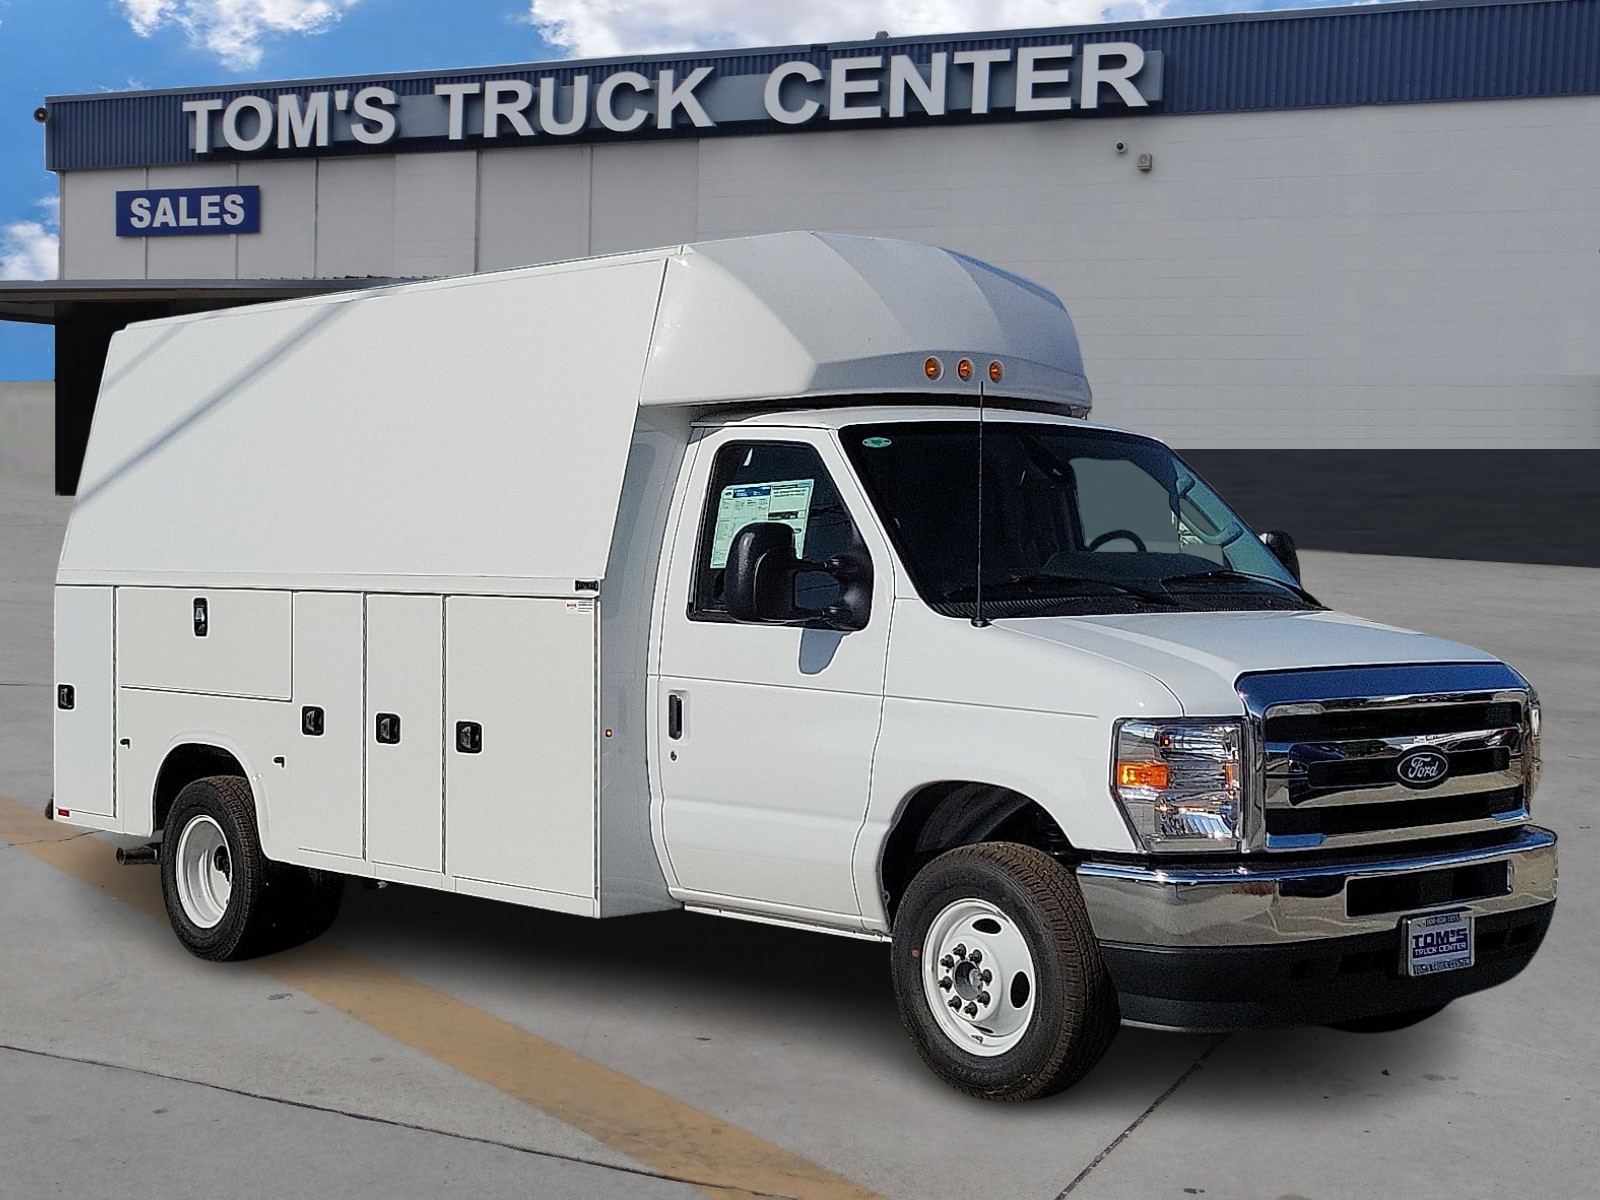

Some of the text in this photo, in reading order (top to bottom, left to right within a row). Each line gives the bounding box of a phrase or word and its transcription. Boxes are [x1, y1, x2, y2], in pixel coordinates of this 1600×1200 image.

[182, 41, 1150, 154] TOM'S TRUCK CENTER
[129, 193, 246, 230] SALES
[1407, 756, 1440, 779] Ford
[1411, 927, 1469, 949] TOM'S
[1413, 941, 1467, 957] TRUCK CENTER
